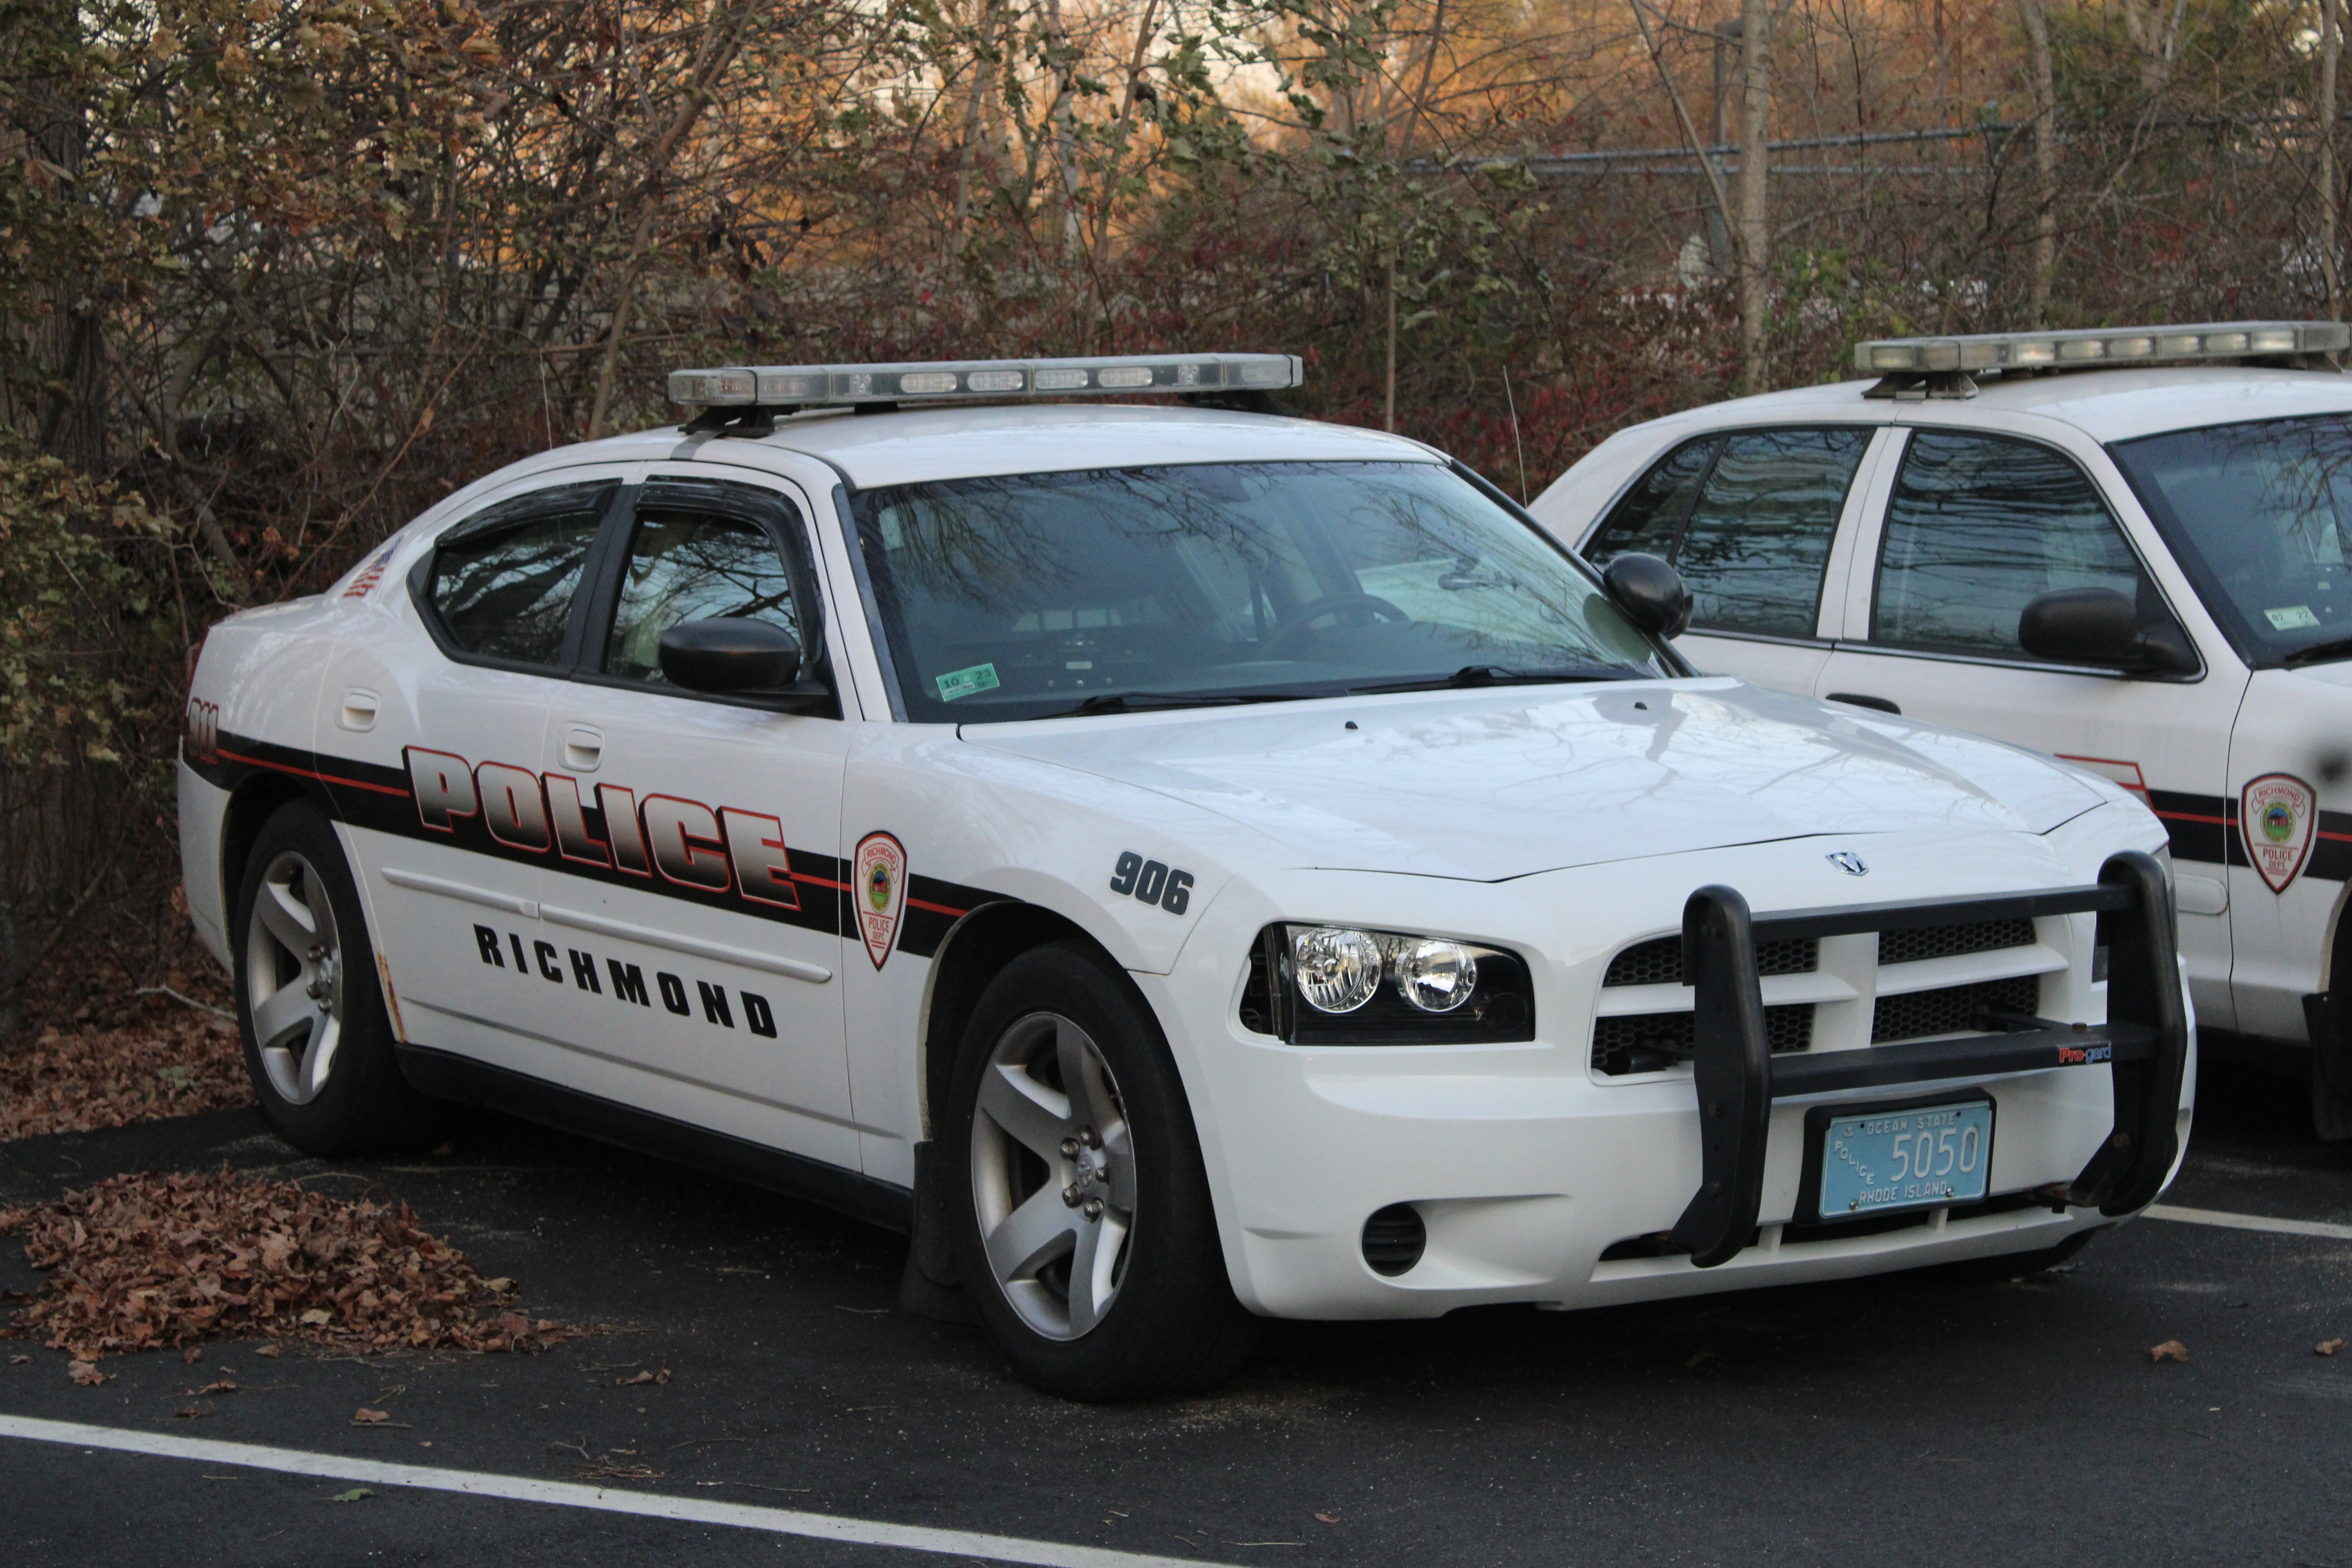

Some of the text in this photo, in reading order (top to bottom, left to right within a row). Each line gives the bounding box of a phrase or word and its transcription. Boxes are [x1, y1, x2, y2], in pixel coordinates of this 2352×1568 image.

[2258, 787, 2300, 800] RICHMOND
[402, 745, 801, 912] POLICE
[867, 846, 896, 864] RICHMOND
[2263, 848, 2293, 861] POLICE
[1110, 851, 1194, 916] 906
[869, 916, 889, 933] POLICE
[473, 923, 777, 1039] RICHMOND
[1867, 1113, 1955, 1135] OCEAN STATE
[1834, 1140, 1875, 1185] POLICE
[1890, 1126, 1979, 1182] 5050
[1859, 1181, 1948, 1204] RHODE ISLAND
